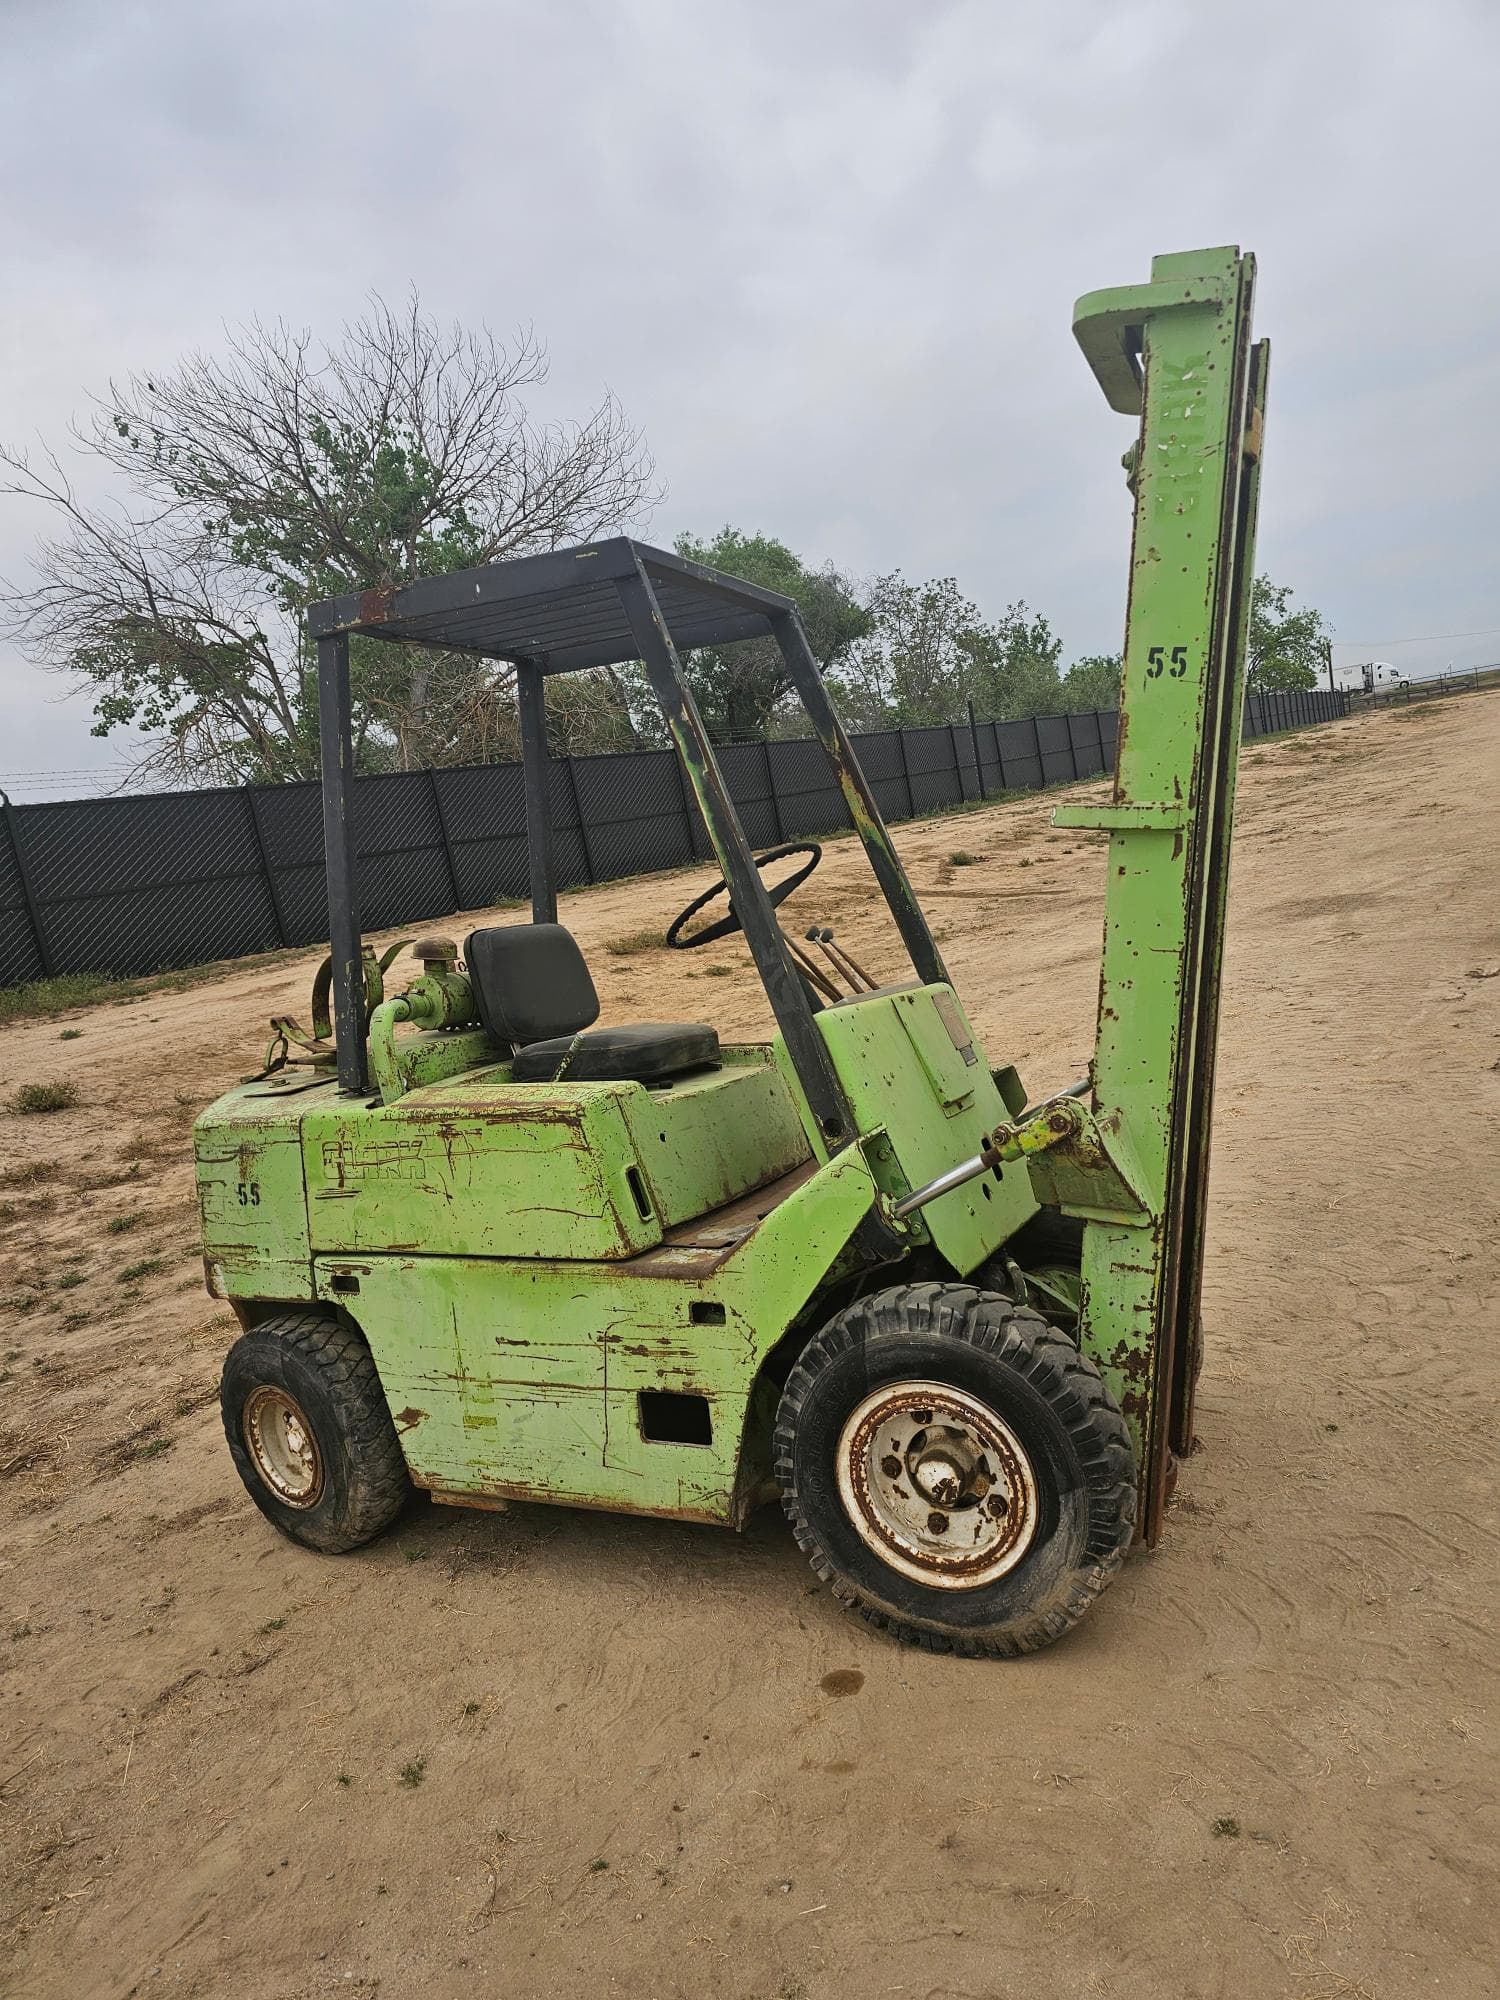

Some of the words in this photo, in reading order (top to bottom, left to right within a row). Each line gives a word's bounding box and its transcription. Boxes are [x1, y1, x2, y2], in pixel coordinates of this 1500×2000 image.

[1146, 646, 1188, 679] 55
[322, 1140, 426, 1180] CLARK
[238, 1182, 260, 1206] 55
